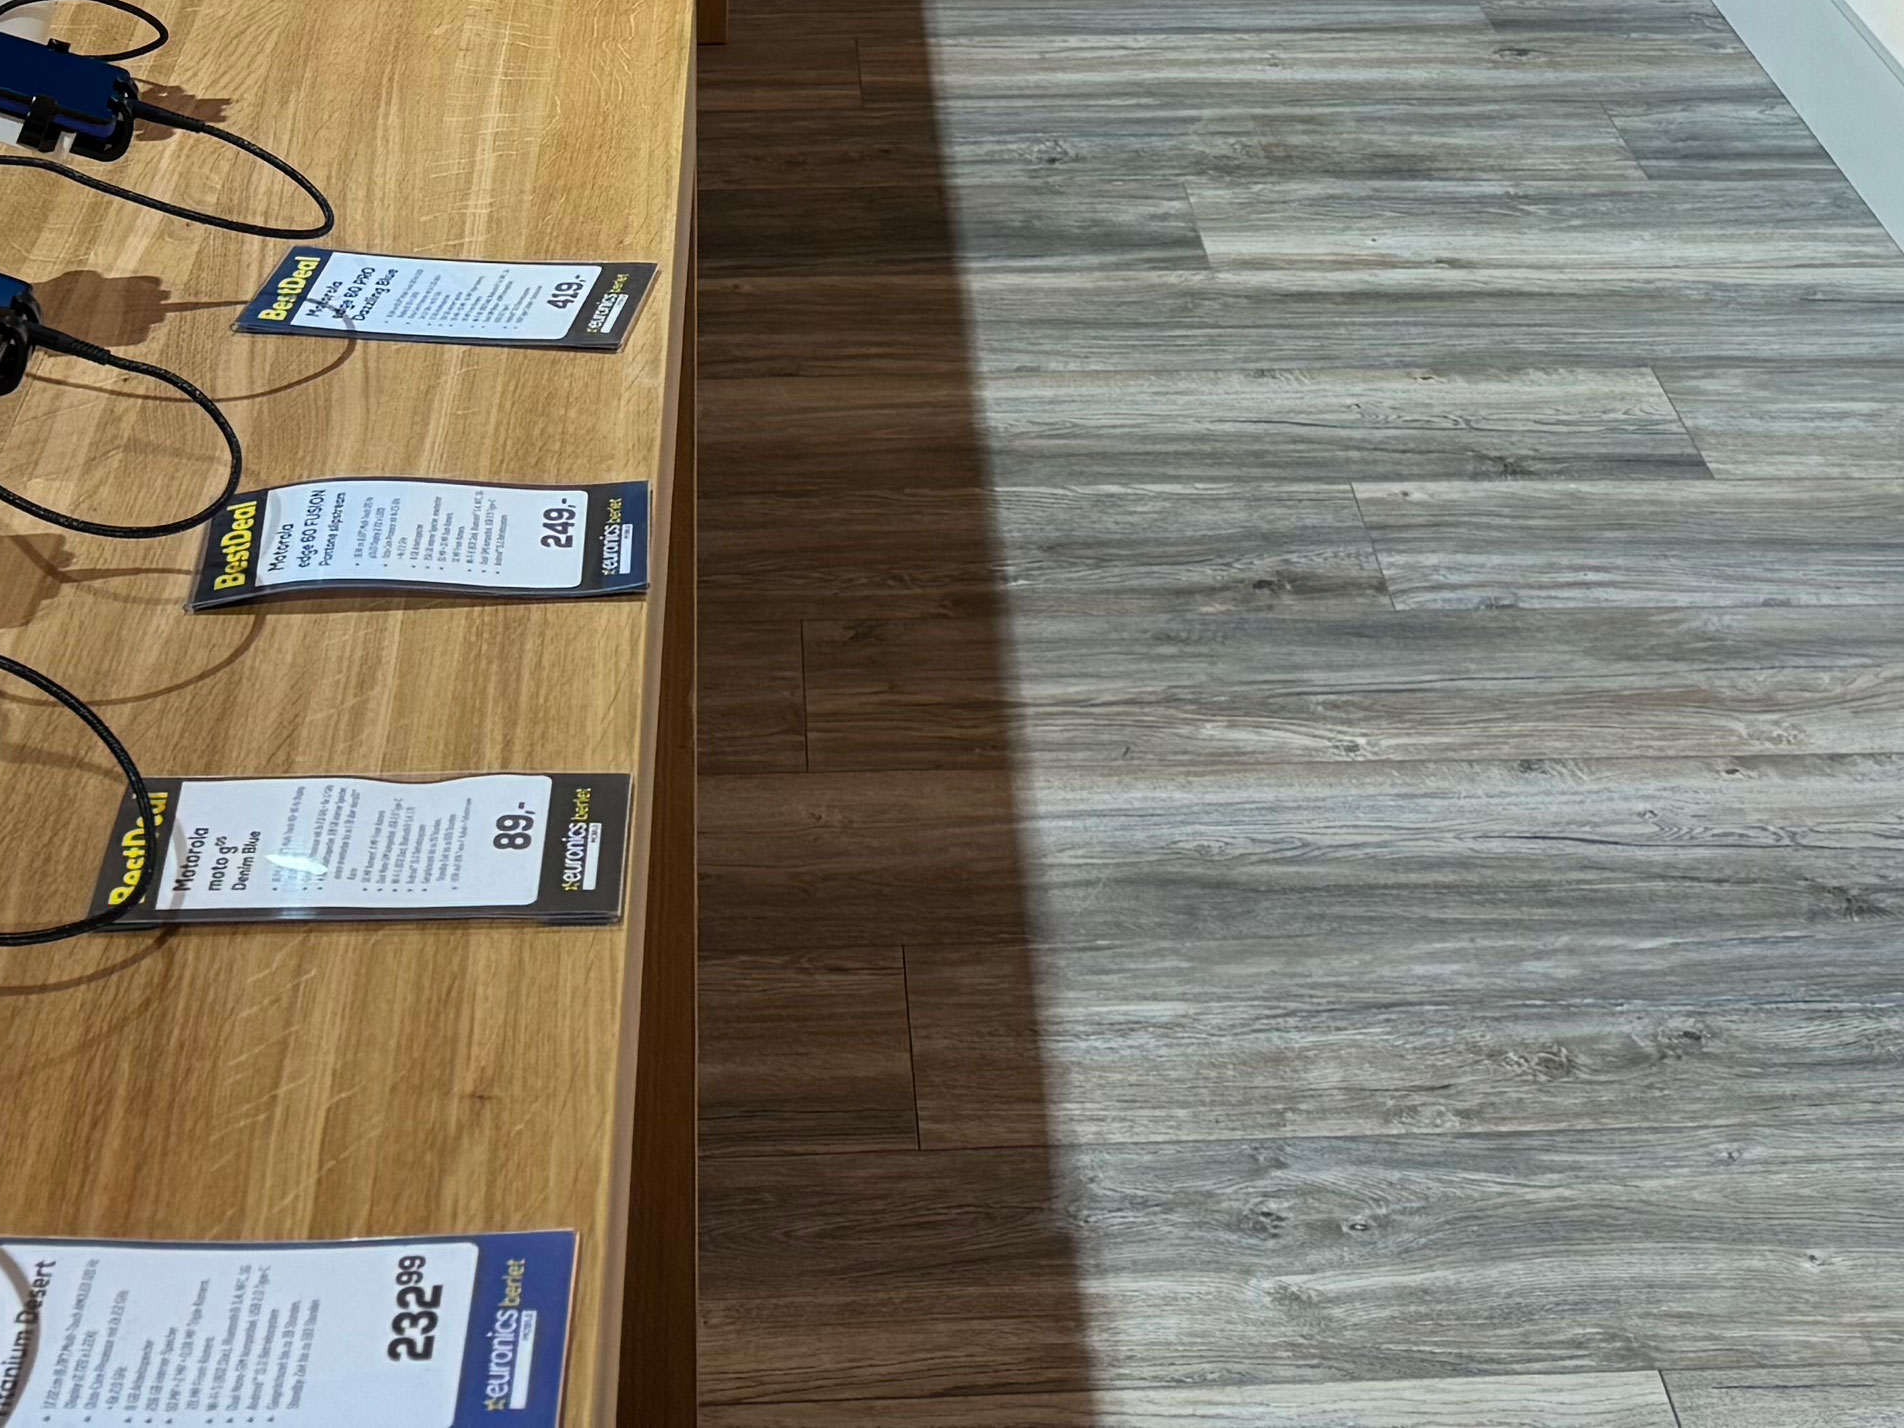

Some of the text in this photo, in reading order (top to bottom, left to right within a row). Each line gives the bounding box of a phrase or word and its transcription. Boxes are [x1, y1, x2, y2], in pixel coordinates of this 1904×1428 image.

[257, 255, 321, 322] BestDeal
[305, 280, 343, 318] Motorola
[304, 489, 326, 527] FUSION
[540, 497, 577, 549] 249,-
[213, 500, 258, 591] BestDeal
[267, 523, 295, 573] Motorola
[296, 544, 319, 569] edge
[599, 524, 621, 568] euronics
[492, 801, 536, 851] 89,-
[561, 821, 587, 883] euronics
[172, 827, 209, 892] Motorola
[208, 853, 229, 892] moto
[231, 830, 262, 891] Denim Blue
[15, 1259, 57, 1325] Desert
[487, 1258, 526, 1399] euronics berlet
